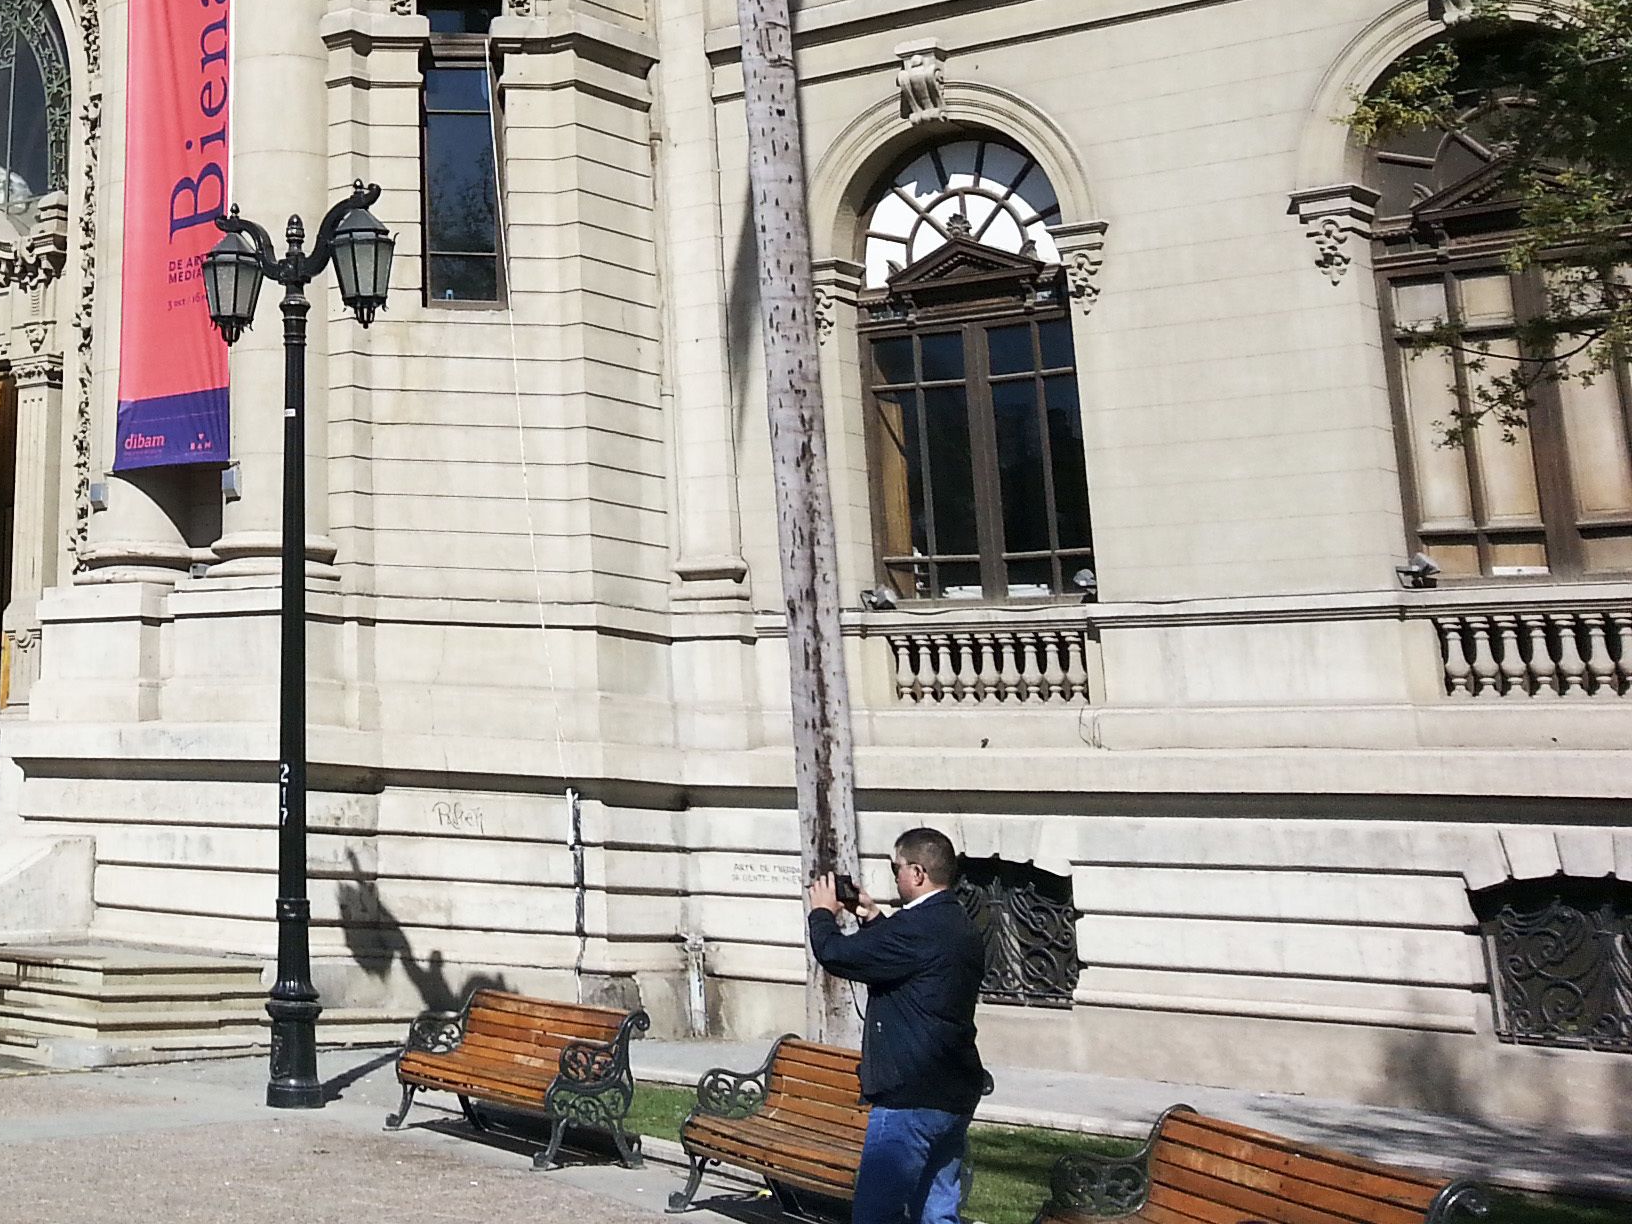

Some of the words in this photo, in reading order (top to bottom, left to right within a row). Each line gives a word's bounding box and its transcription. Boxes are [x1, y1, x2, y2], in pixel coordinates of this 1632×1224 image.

[169, 259, 183, 272] DE
[168, 268, 202, 285] MEDIA
[124, 432, 166, 451] dibam
